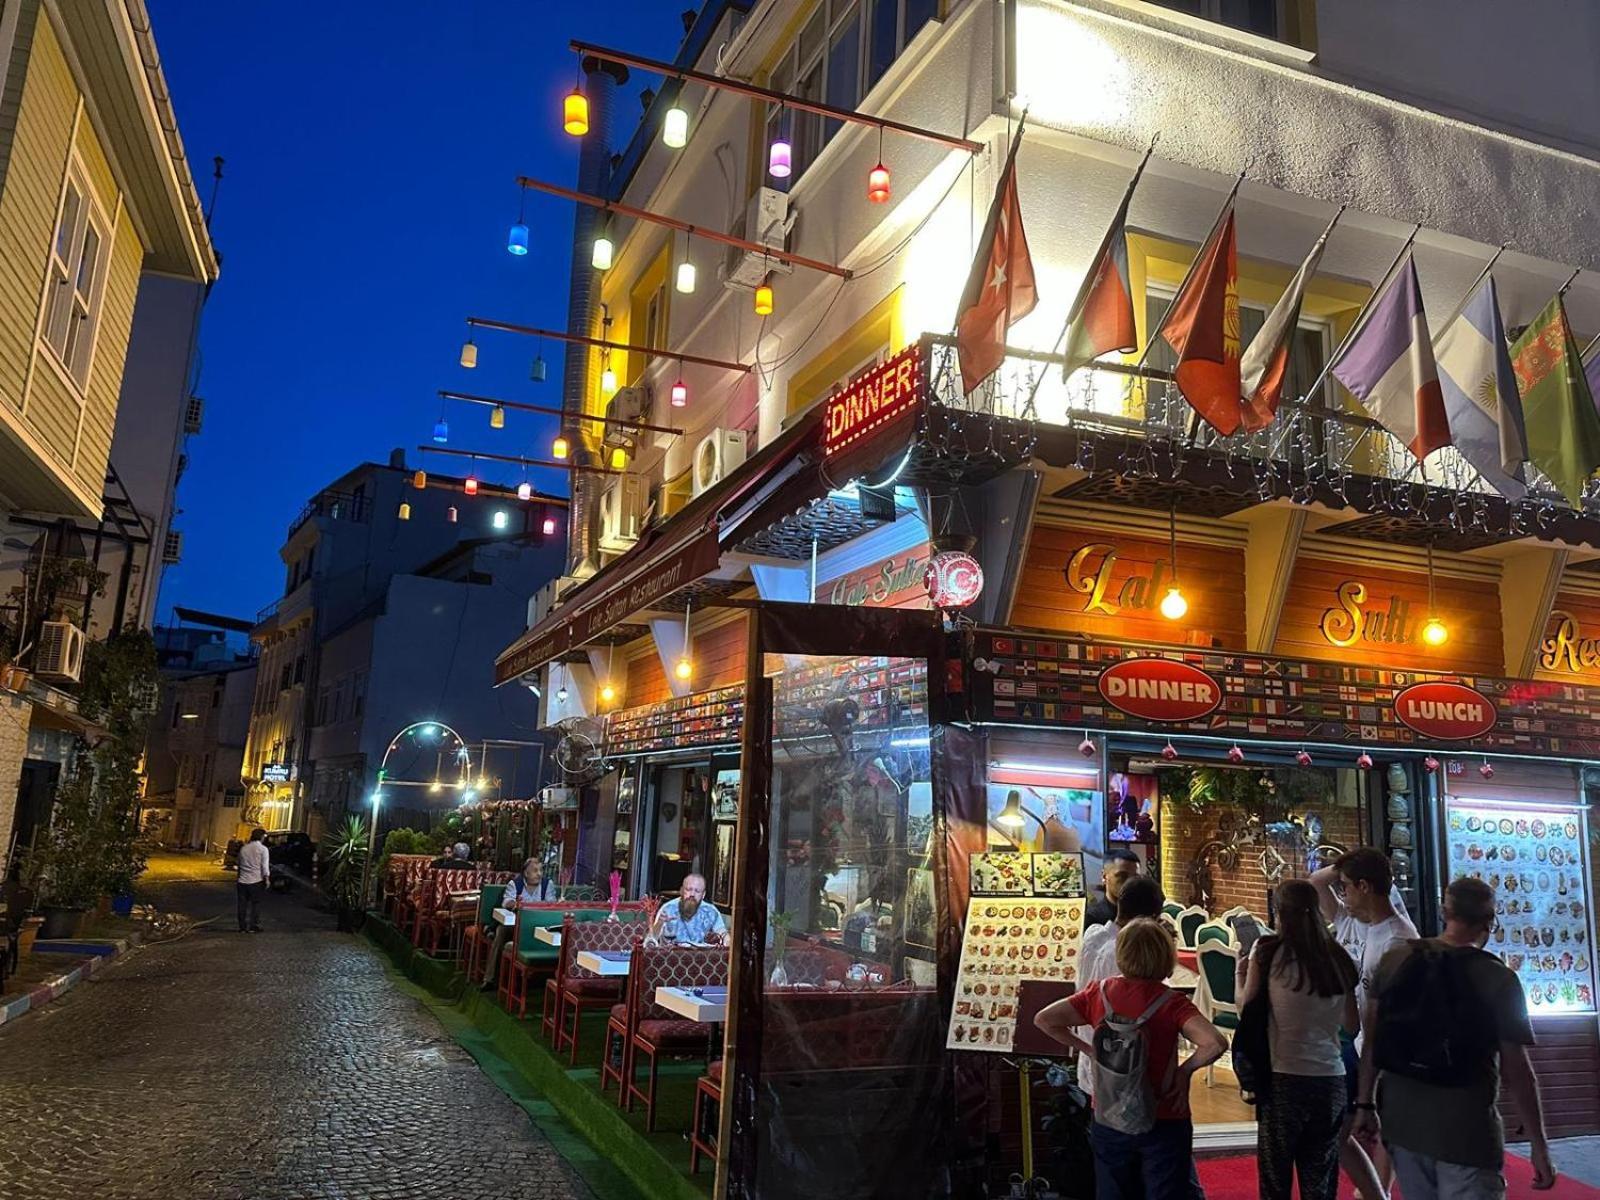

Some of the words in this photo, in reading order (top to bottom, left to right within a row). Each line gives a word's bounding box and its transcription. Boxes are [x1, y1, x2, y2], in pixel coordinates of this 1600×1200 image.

[831, 358, 912, 438] DINNER
[630, 560, 682, 604] Restaurant
[872, 558, 929, 603] Sulta
[1066, 543, 1166, 615] Lal
[1322, 582, 1418, 647] Sult
[1541, 610, 1600, 672] Re
[1107, 677, 1213, 703] DINNER
[1408, 699, 1483, 722] LUNCH
